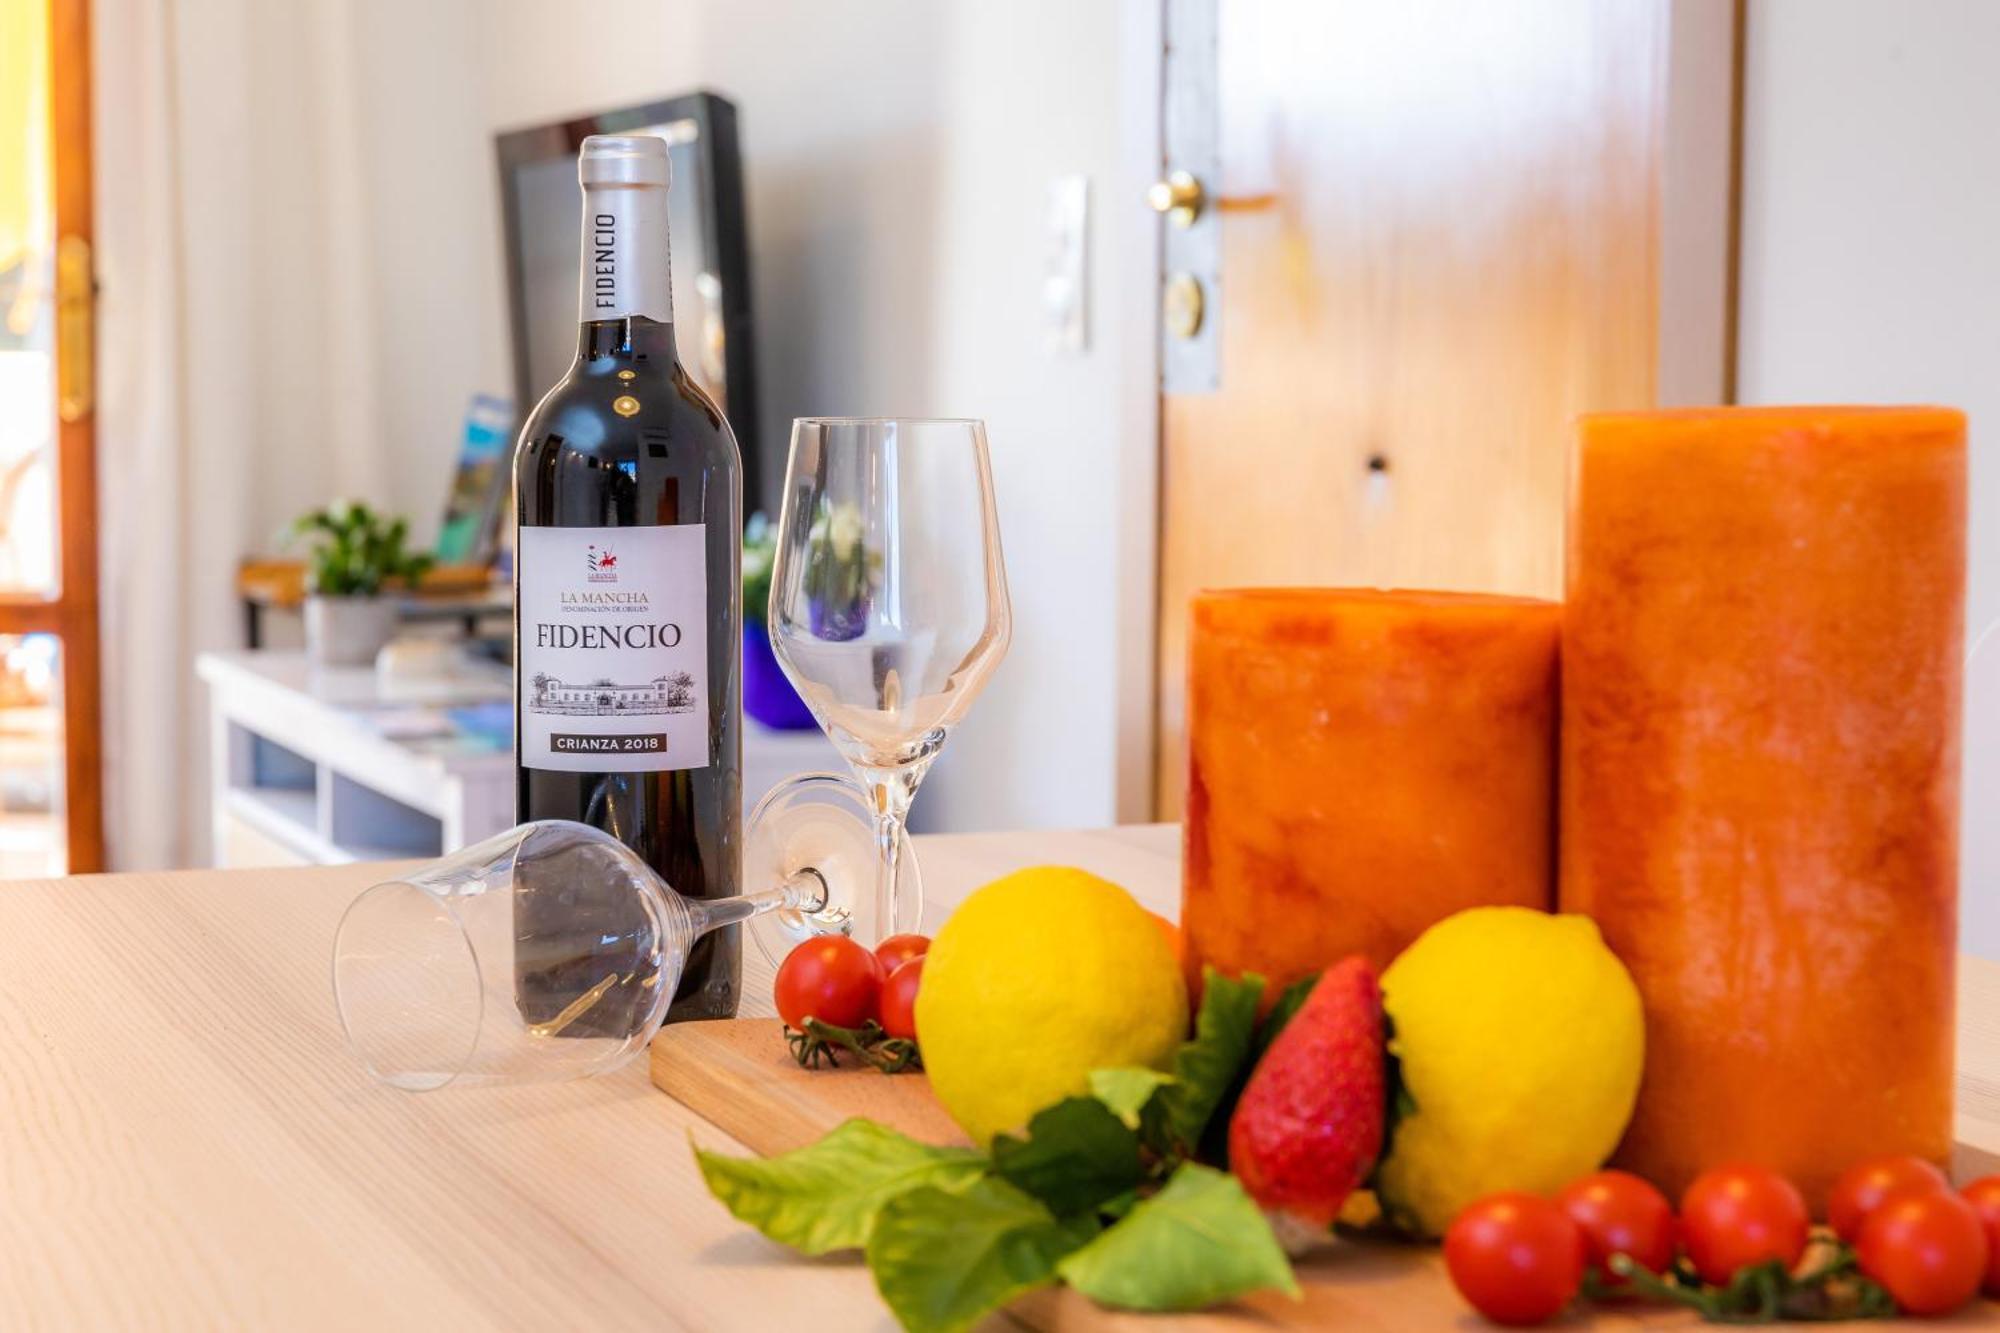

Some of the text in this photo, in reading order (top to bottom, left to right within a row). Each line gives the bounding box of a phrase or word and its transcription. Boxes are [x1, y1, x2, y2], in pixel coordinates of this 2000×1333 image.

[595, 214, 616, 308] FIDENCIO
[560, 592, 649, 603] LA MANCHA
[536, 623, 682, 649] FIDENCIO
[556, 738, 659, 750] CRIANZA 2018
